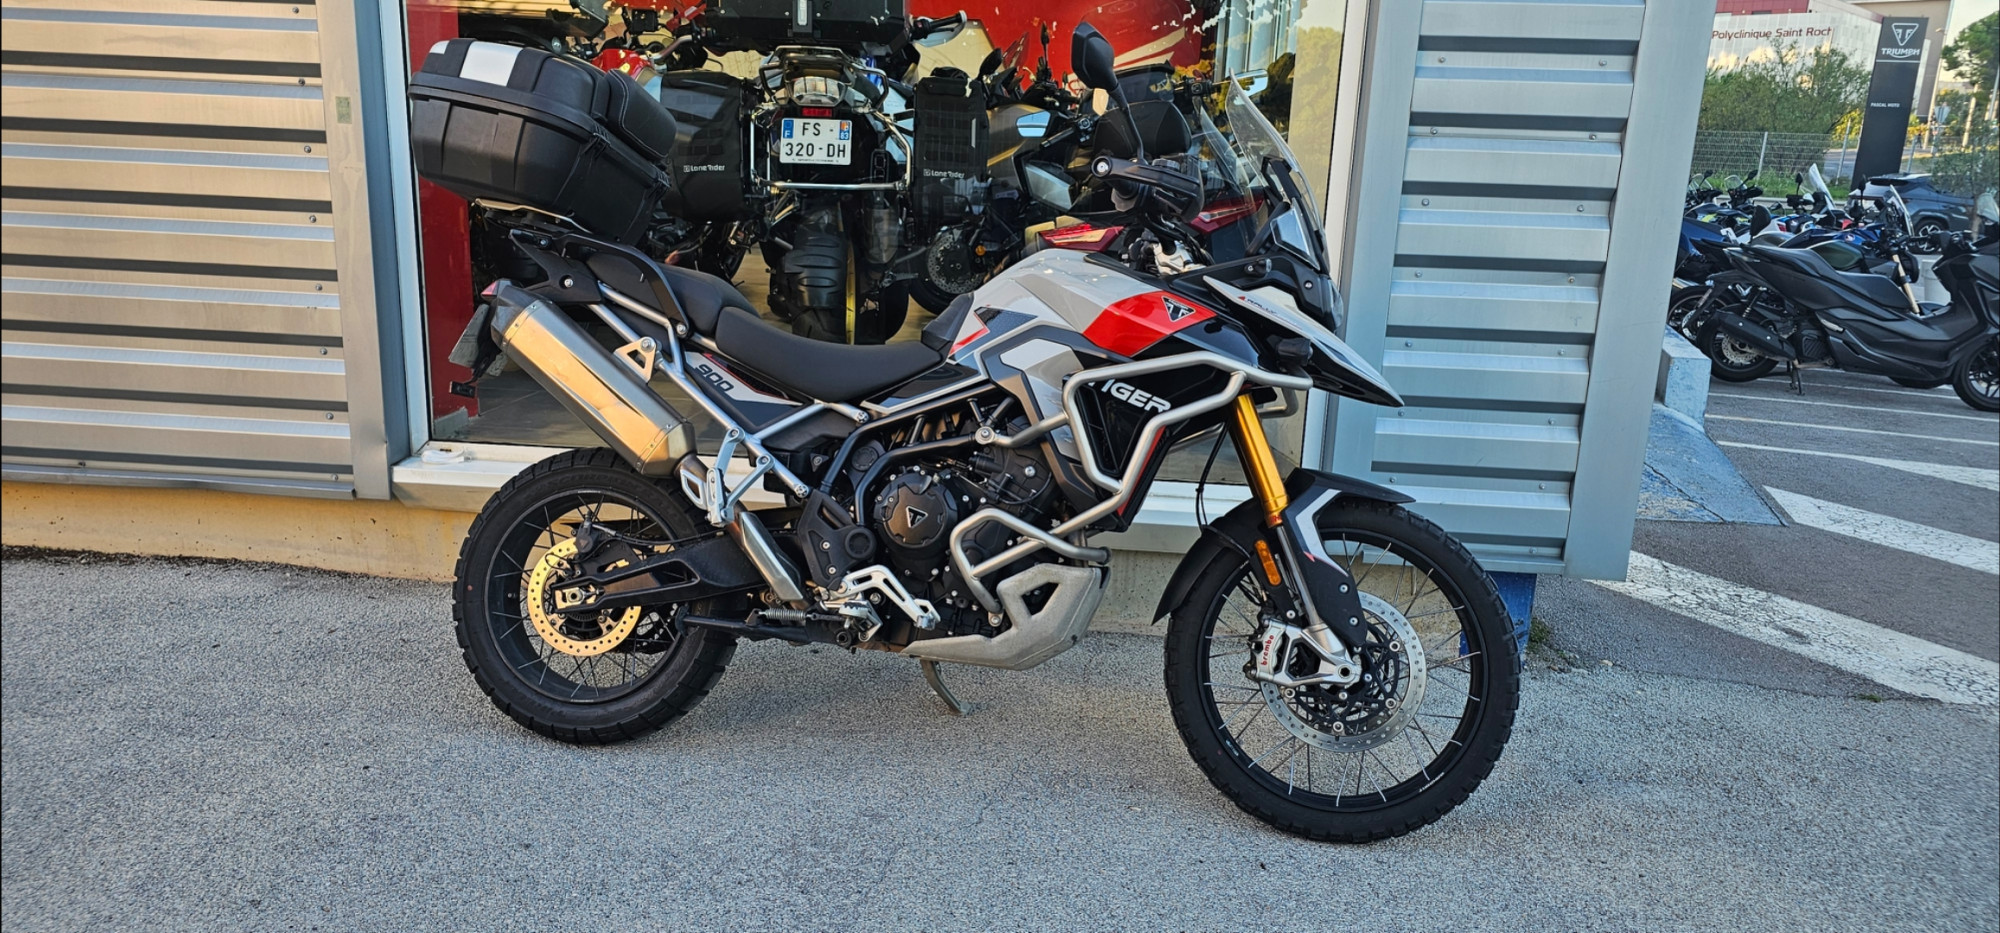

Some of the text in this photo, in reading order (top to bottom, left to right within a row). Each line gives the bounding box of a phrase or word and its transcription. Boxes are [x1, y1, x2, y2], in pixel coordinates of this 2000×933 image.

[1711, 29, 1772, 40] Polyclinique
[1775, 28, 1803, 38] Saint
[1881, 48, 1920, 58] TRIUMPH
[784, 130, 791, 138] F
[802, 122, 821, 136] FS
[840, 132, 849, 140] 83
[695, 364, 735, 391] 900
[1087, 379, 1172, 413] IGER
[1260, 634, 1275, 666] brembo
